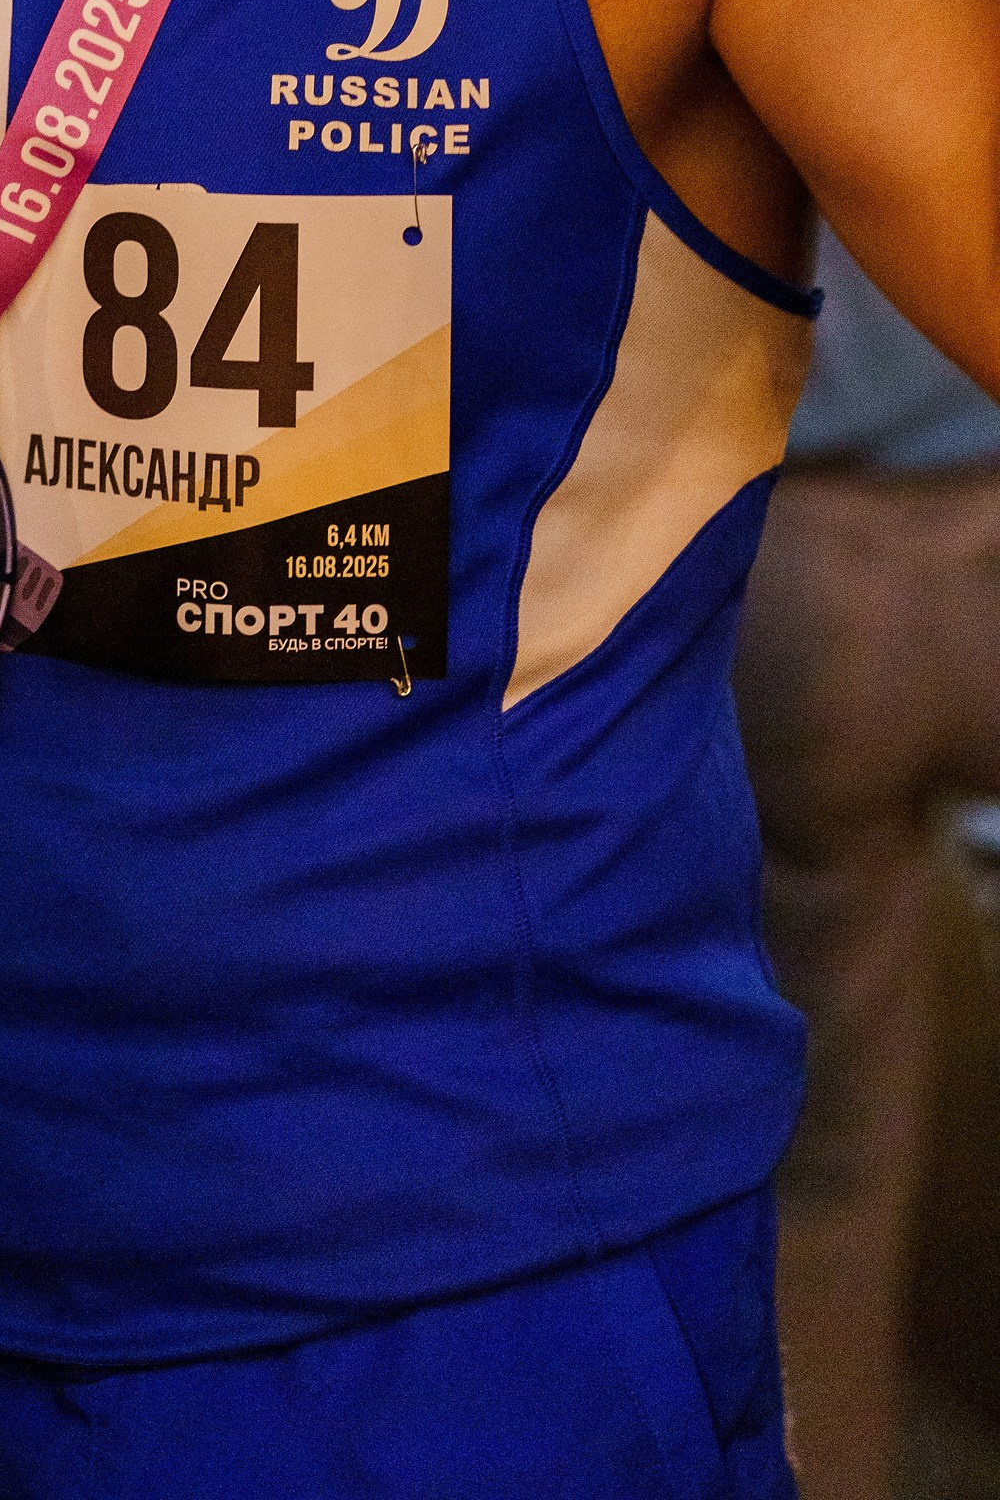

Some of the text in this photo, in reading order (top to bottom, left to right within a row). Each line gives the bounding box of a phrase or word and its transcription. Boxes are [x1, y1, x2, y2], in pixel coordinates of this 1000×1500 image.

[270, 74, 490, 109] RUSSIAN
[288, 120, 470, 156] POLICE
[82, 211, 315, 429] 84
[24, 433, 261, 513] АЛЕКСАНДР
[327, 524, 357, 550] 6,4
[285, 554, 390, 578] 16.08.2025
[176, 577, 228, 600] PRO
[176, 602, 389, 636] СПОРТ 40
[268, 637, 388, 652] БУДЬ В СПОРТЕ!
